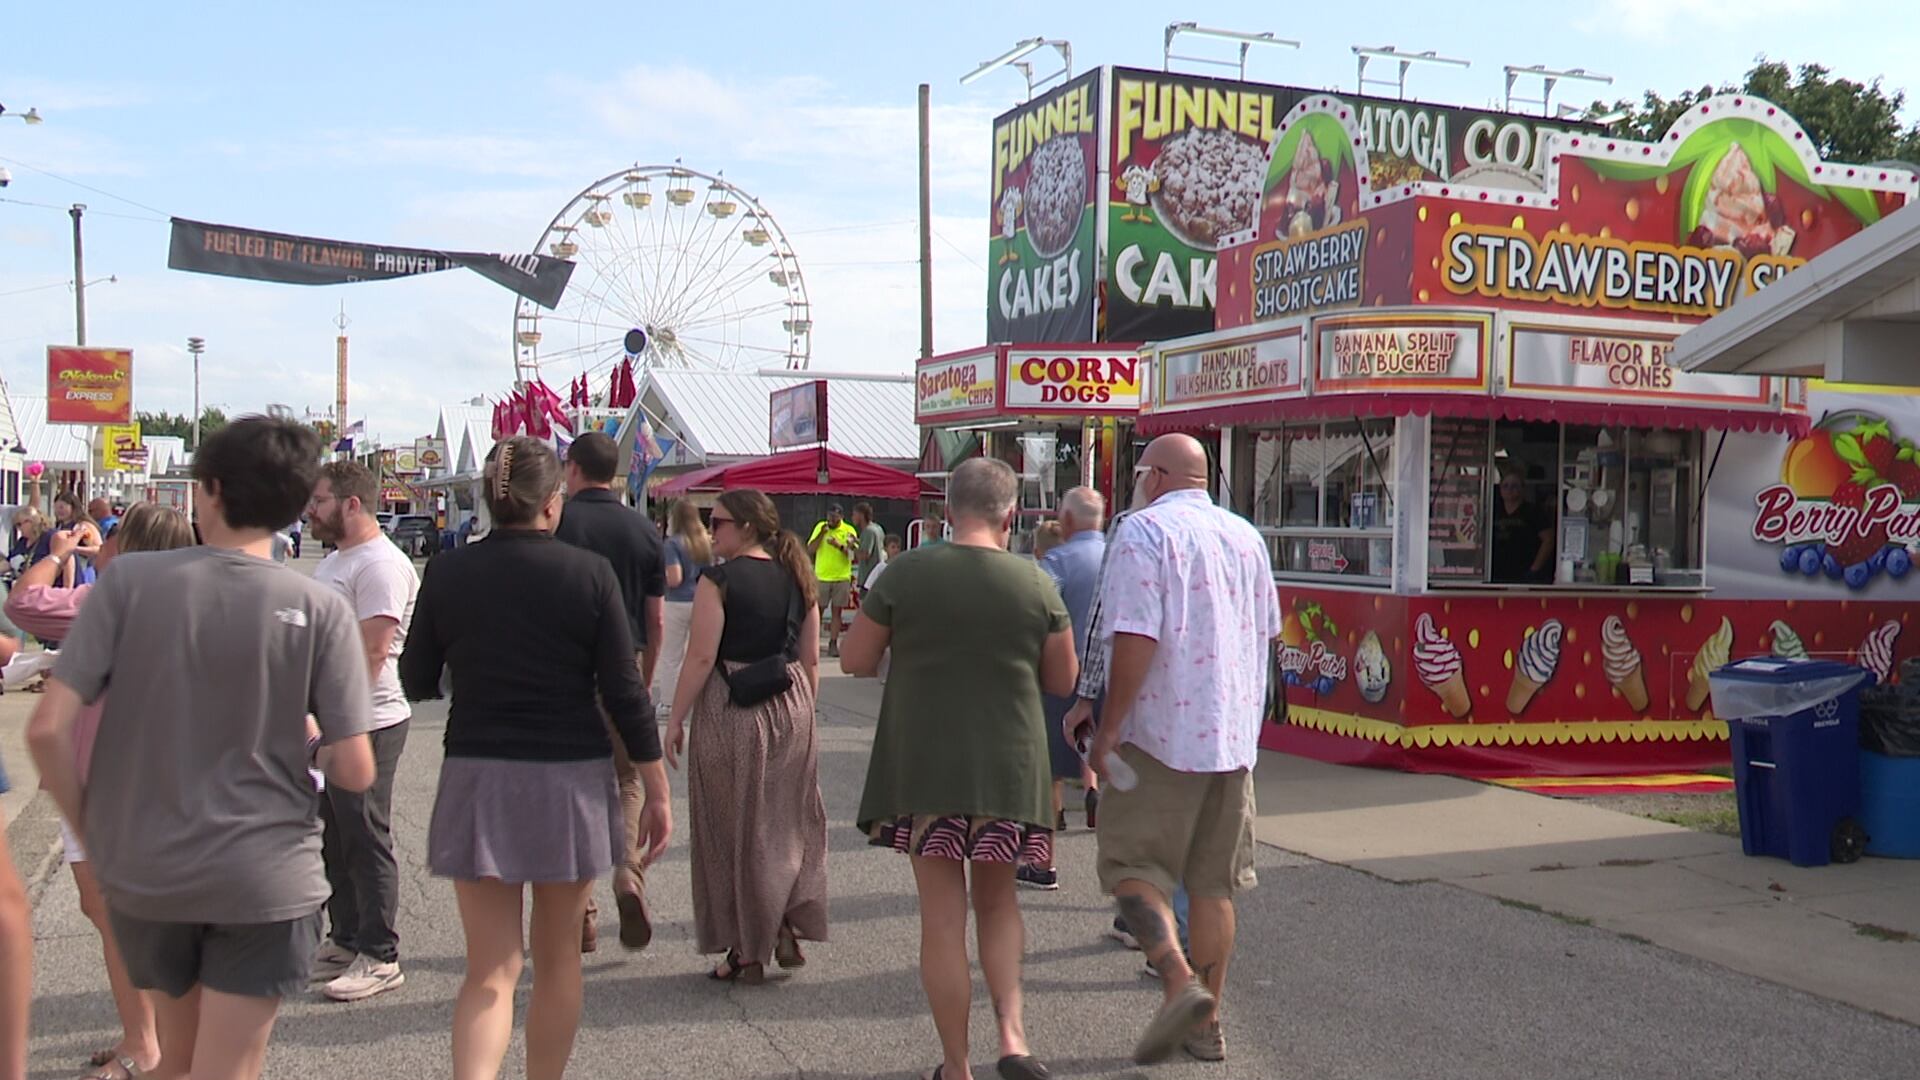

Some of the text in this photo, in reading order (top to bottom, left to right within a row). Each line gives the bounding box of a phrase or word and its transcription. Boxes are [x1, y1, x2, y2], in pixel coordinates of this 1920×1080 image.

[1117, 79, 1277, 164] FUNNEL
[994, 84, 1096, 201] FUNNEL
[1360, 105, 1449, 182] ATOGA
[204, 230, 265, 258] FUELED
[272, 240, 296, 262] BY
[374, 252, 436, 274] PROVEN
[1253, 229, 1364, 284] STRAWBERRY
[1448, 232, 1734, 308] STRAWBERRY
[1000, 248, 1081, 320] CAKES
[1115, 244, 1217, 308] CAK
[1255, 267, 1360, 318] SHORTCAKE
[1201, 347, 1257, 373] HANDMADE
[1334, 332, 1457, 353] BANANA SPLIT
[1570, 339, 1643, 366] FLAVOR
[919, 363, 977, 400] Saratoga
[1019, 357, 1138, 387] CORN
[1174, 362, 1288, 397] MILKSHAKES & FLOATS
[1338, 353, 1451, 373] IN A BUCKET
[1608, 364, 1672, 388] CONES
[65, 391, 113, 400] EXPRESS
[967, 387, 994, 406] CHIPS
[1040, 385, 1110, 403] DOGS
[1754, 485, 1920, 545] Berry Pat
[1308, 641, 1347, 680] Patch
